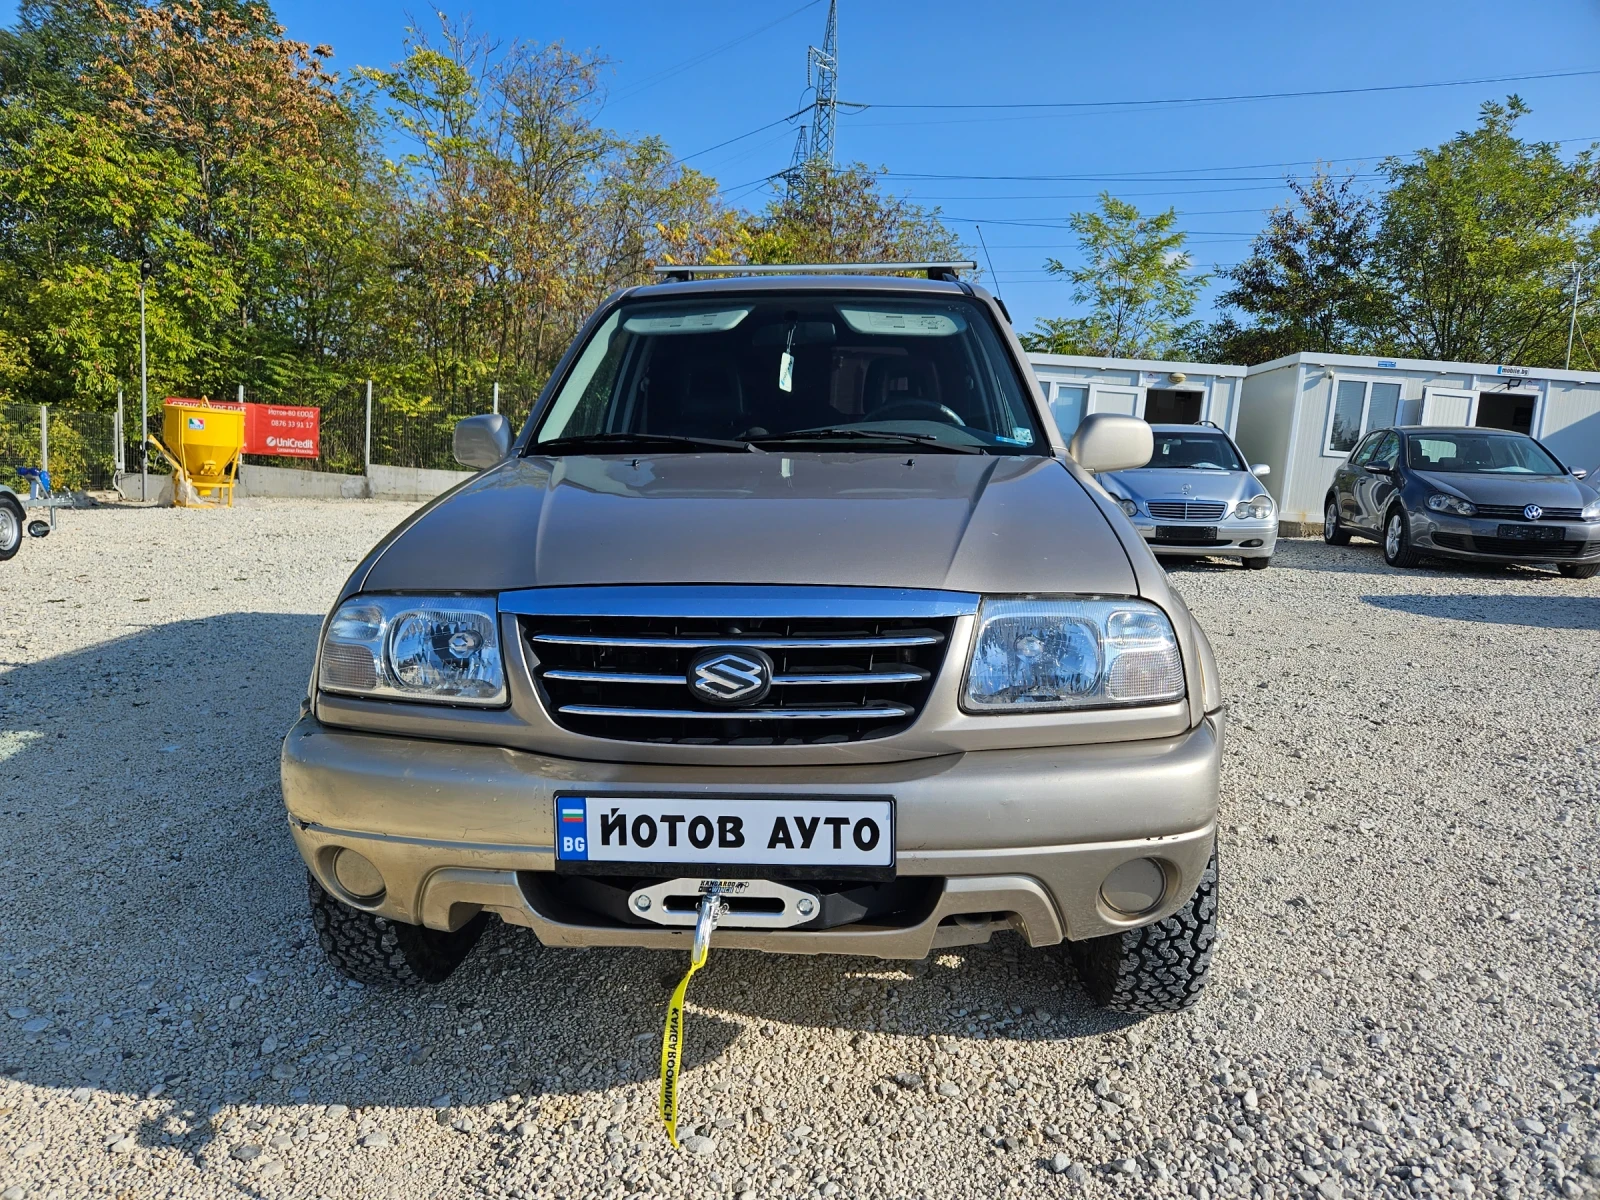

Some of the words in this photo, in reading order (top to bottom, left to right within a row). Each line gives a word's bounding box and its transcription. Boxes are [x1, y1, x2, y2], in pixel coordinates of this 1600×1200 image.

[276, 437, 314, 449] UniCredit
[600, 808, 745, 848] ЙОТОВ
[767, 816, 880, 852] АУТО
[563, 836, 585, 852] BG
